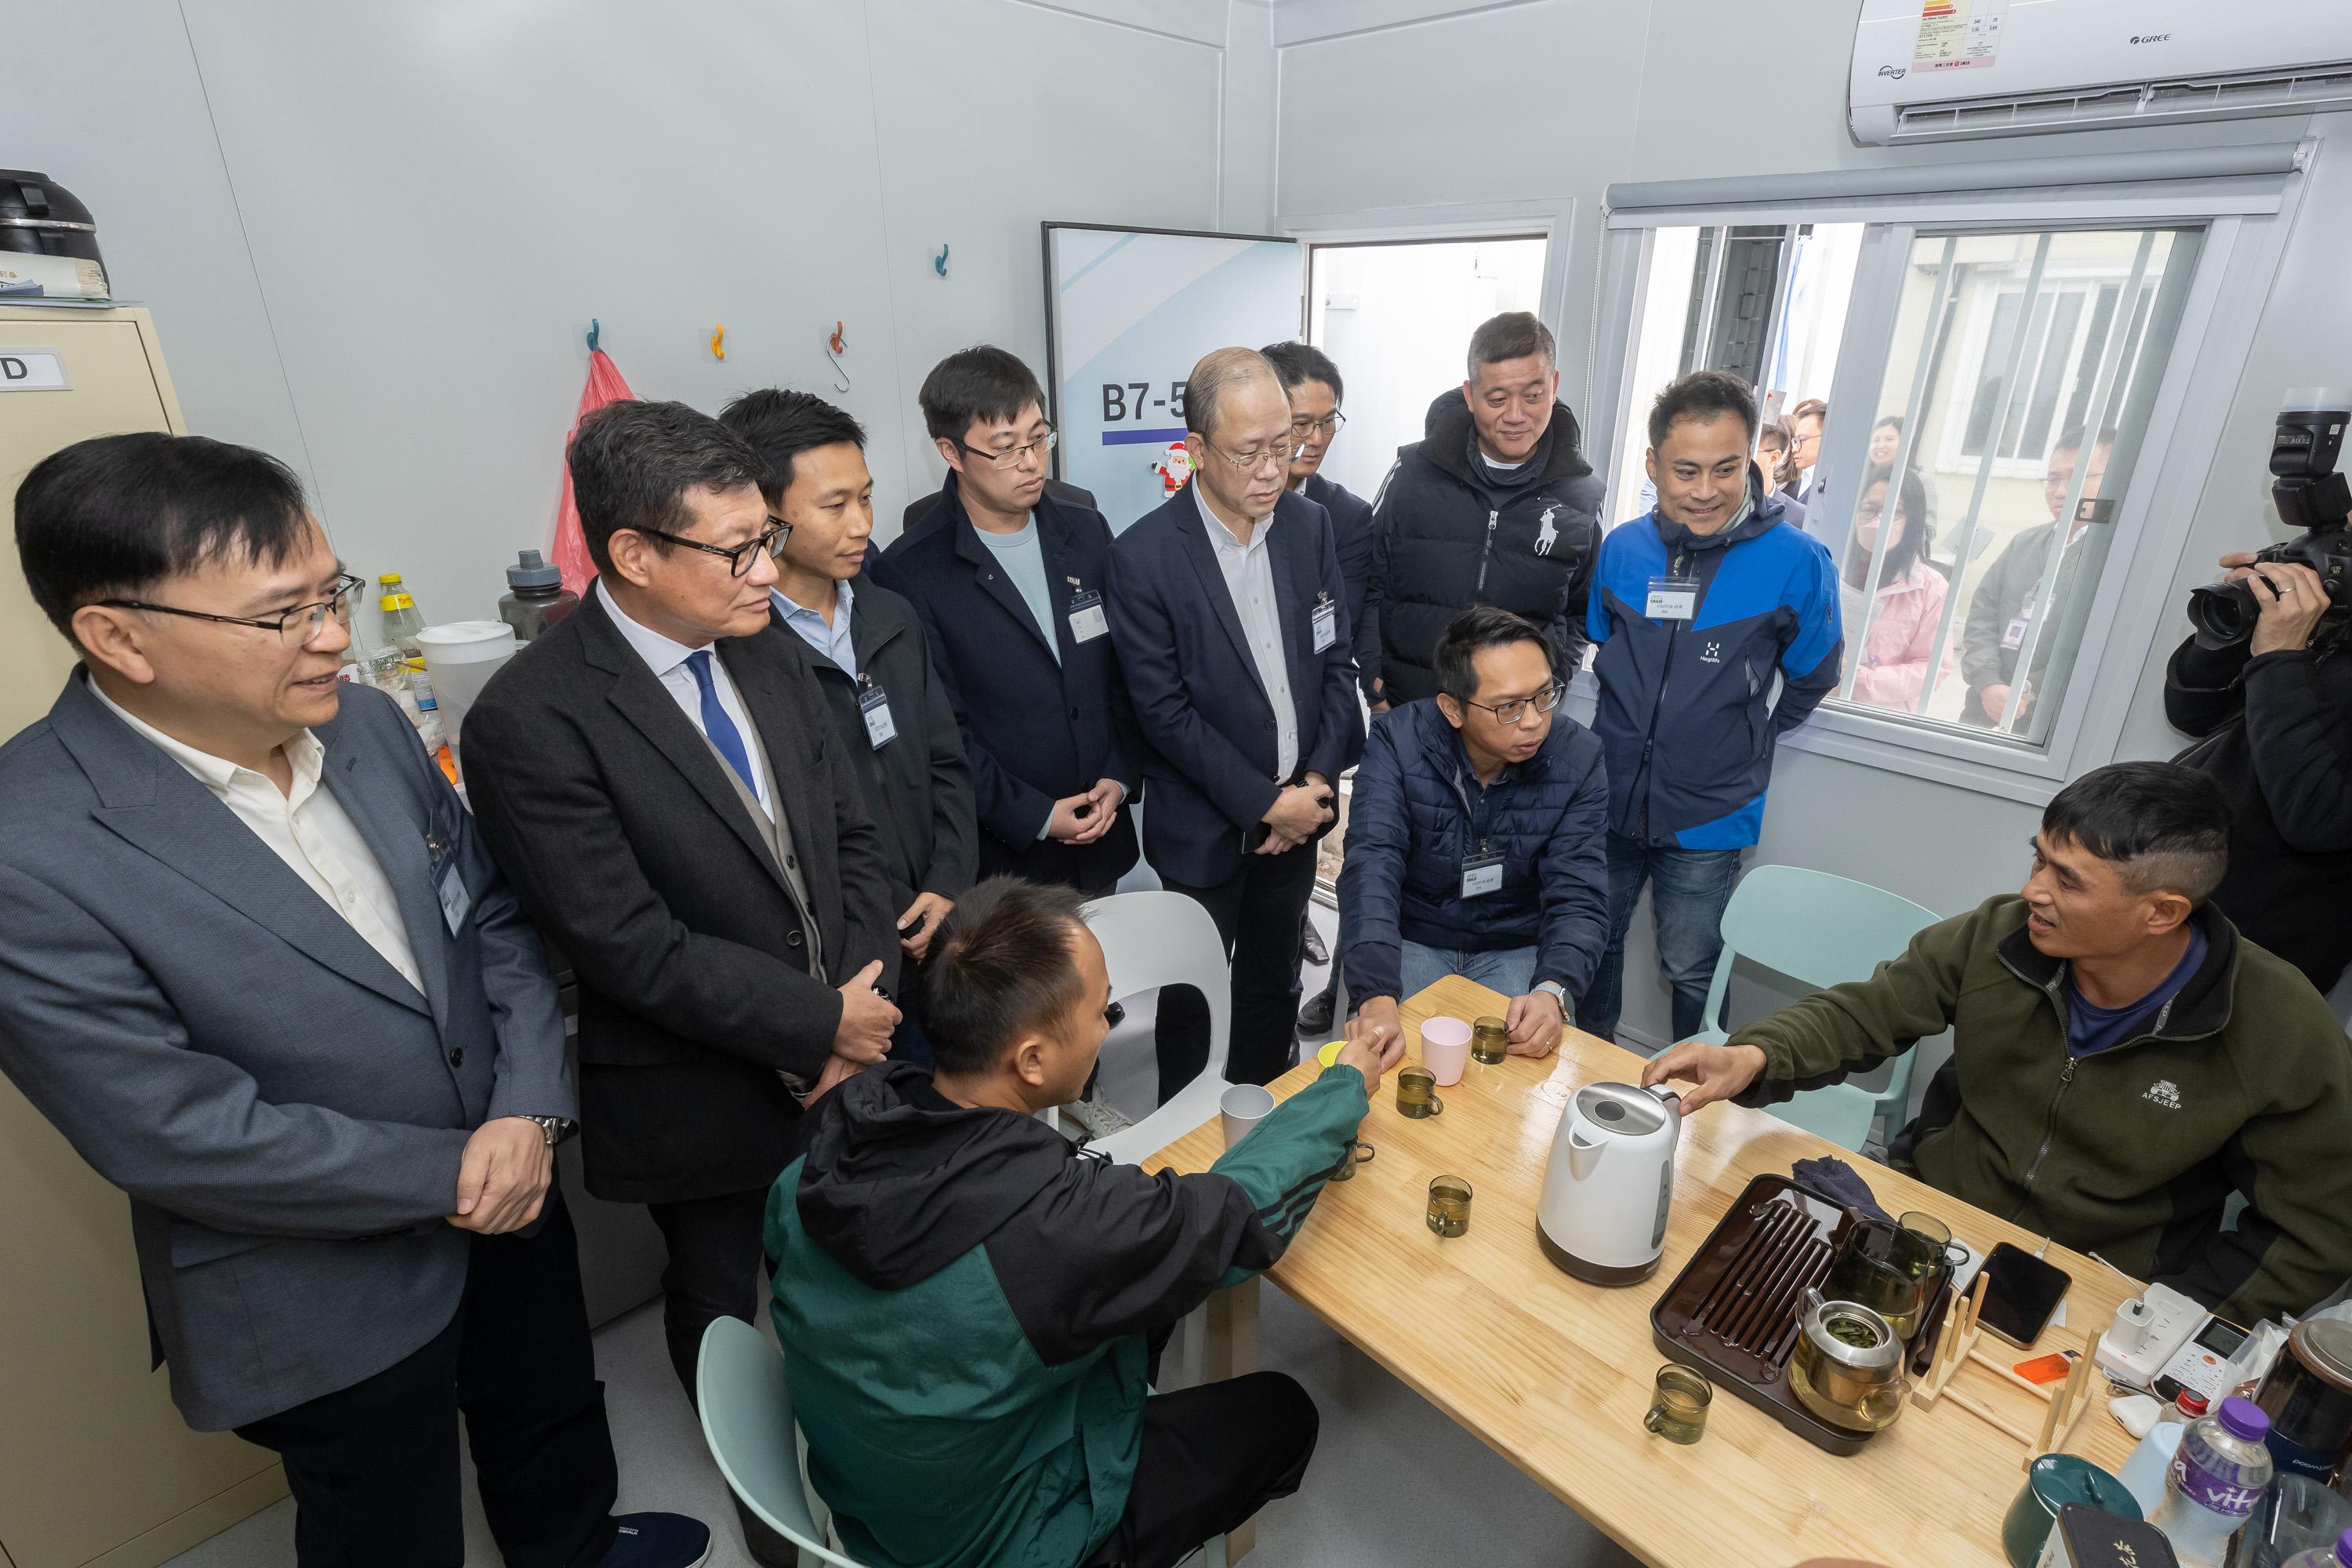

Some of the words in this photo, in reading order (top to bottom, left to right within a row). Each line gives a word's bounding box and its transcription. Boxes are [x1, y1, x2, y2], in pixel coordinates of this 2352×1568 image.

[2141, 34, 2172, 43] GREE
[1877, 68, 1907, 77] INVERTER
[0, 358, 27, 379] D
[2141, 1092, 2182, 1109] AFSJEEP
